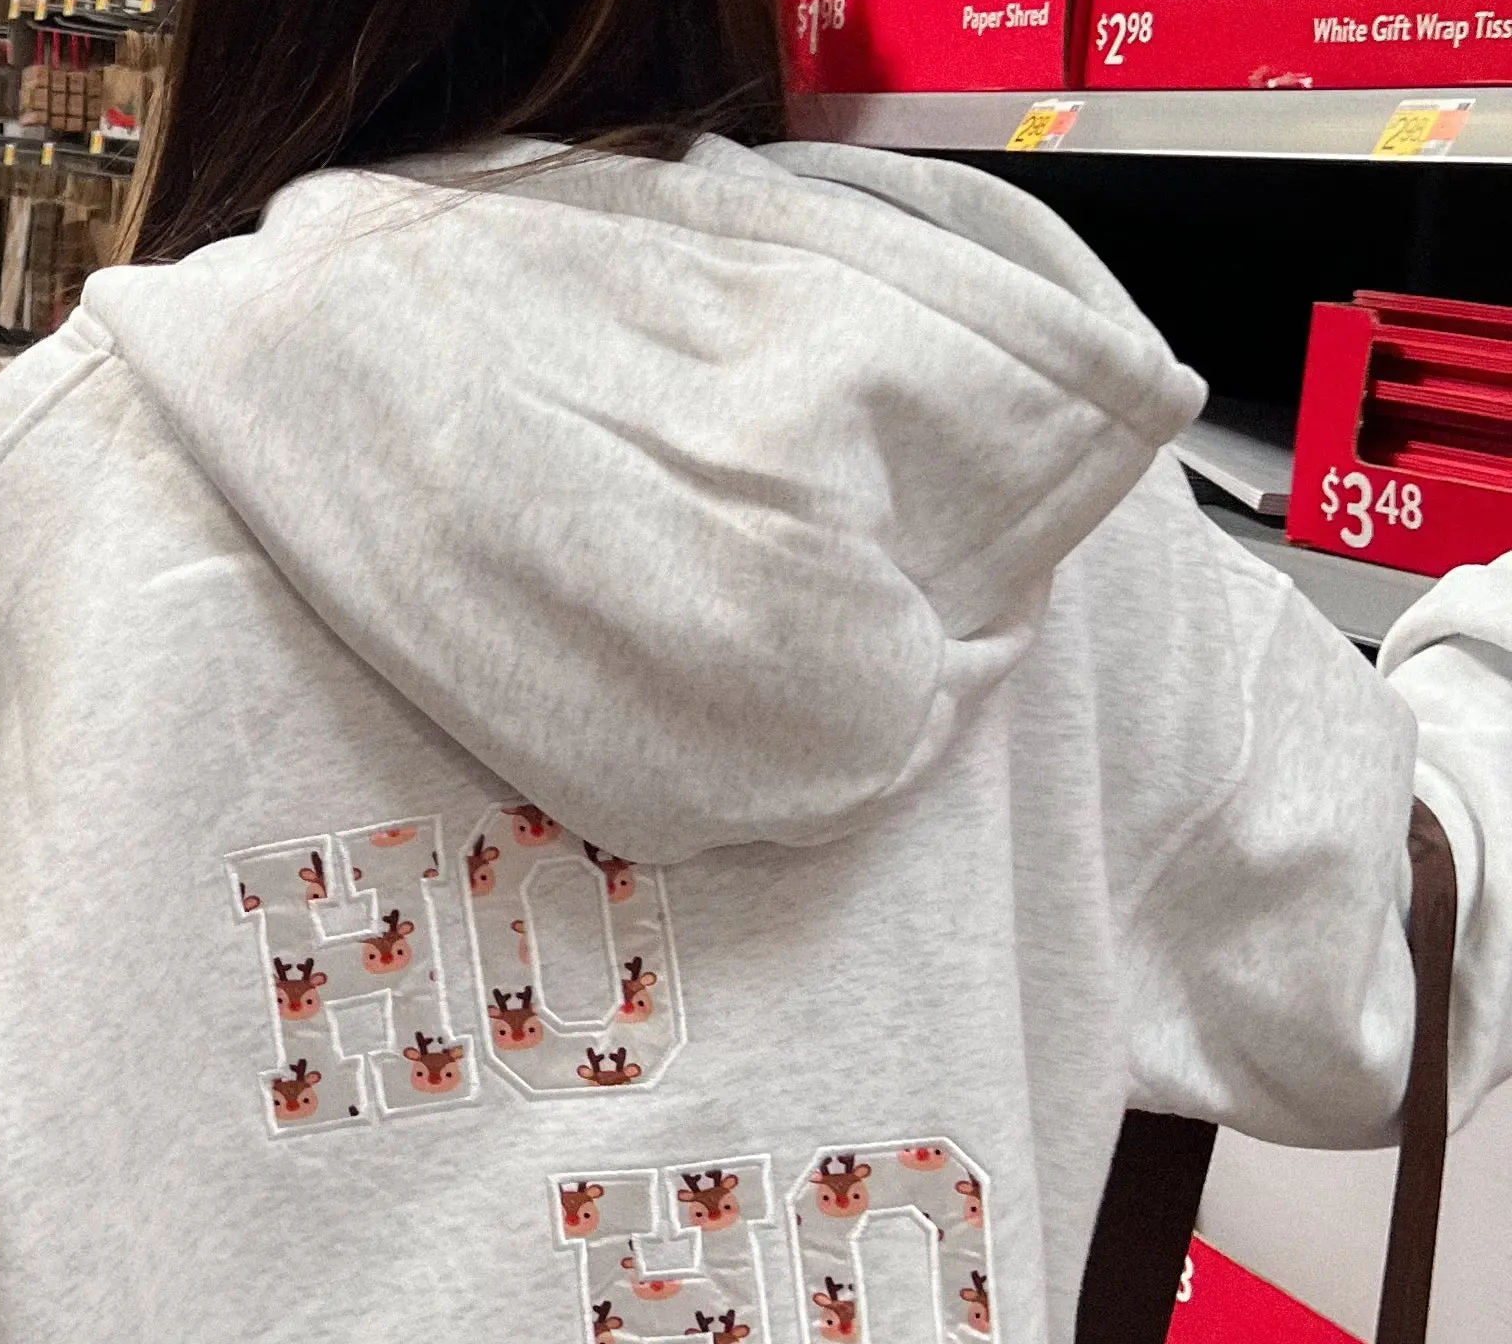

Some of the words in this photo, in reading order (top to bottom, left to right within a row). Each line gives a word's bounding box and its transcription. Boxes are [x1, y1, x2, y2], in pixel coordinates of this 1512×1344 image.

[962, 5, 1004, 37] Paper
[1005, 1, 1050, 29] Shred
[1095, 11, 1154, 65] $298
[1313, 16, 1367, 43] White
[1371, 14, 1411, 42] Gift
[1414, 13, 1469, 48] Wrap
[1320, 466, 1424, 548] $348
[224, 801, 686, 1140] HO
